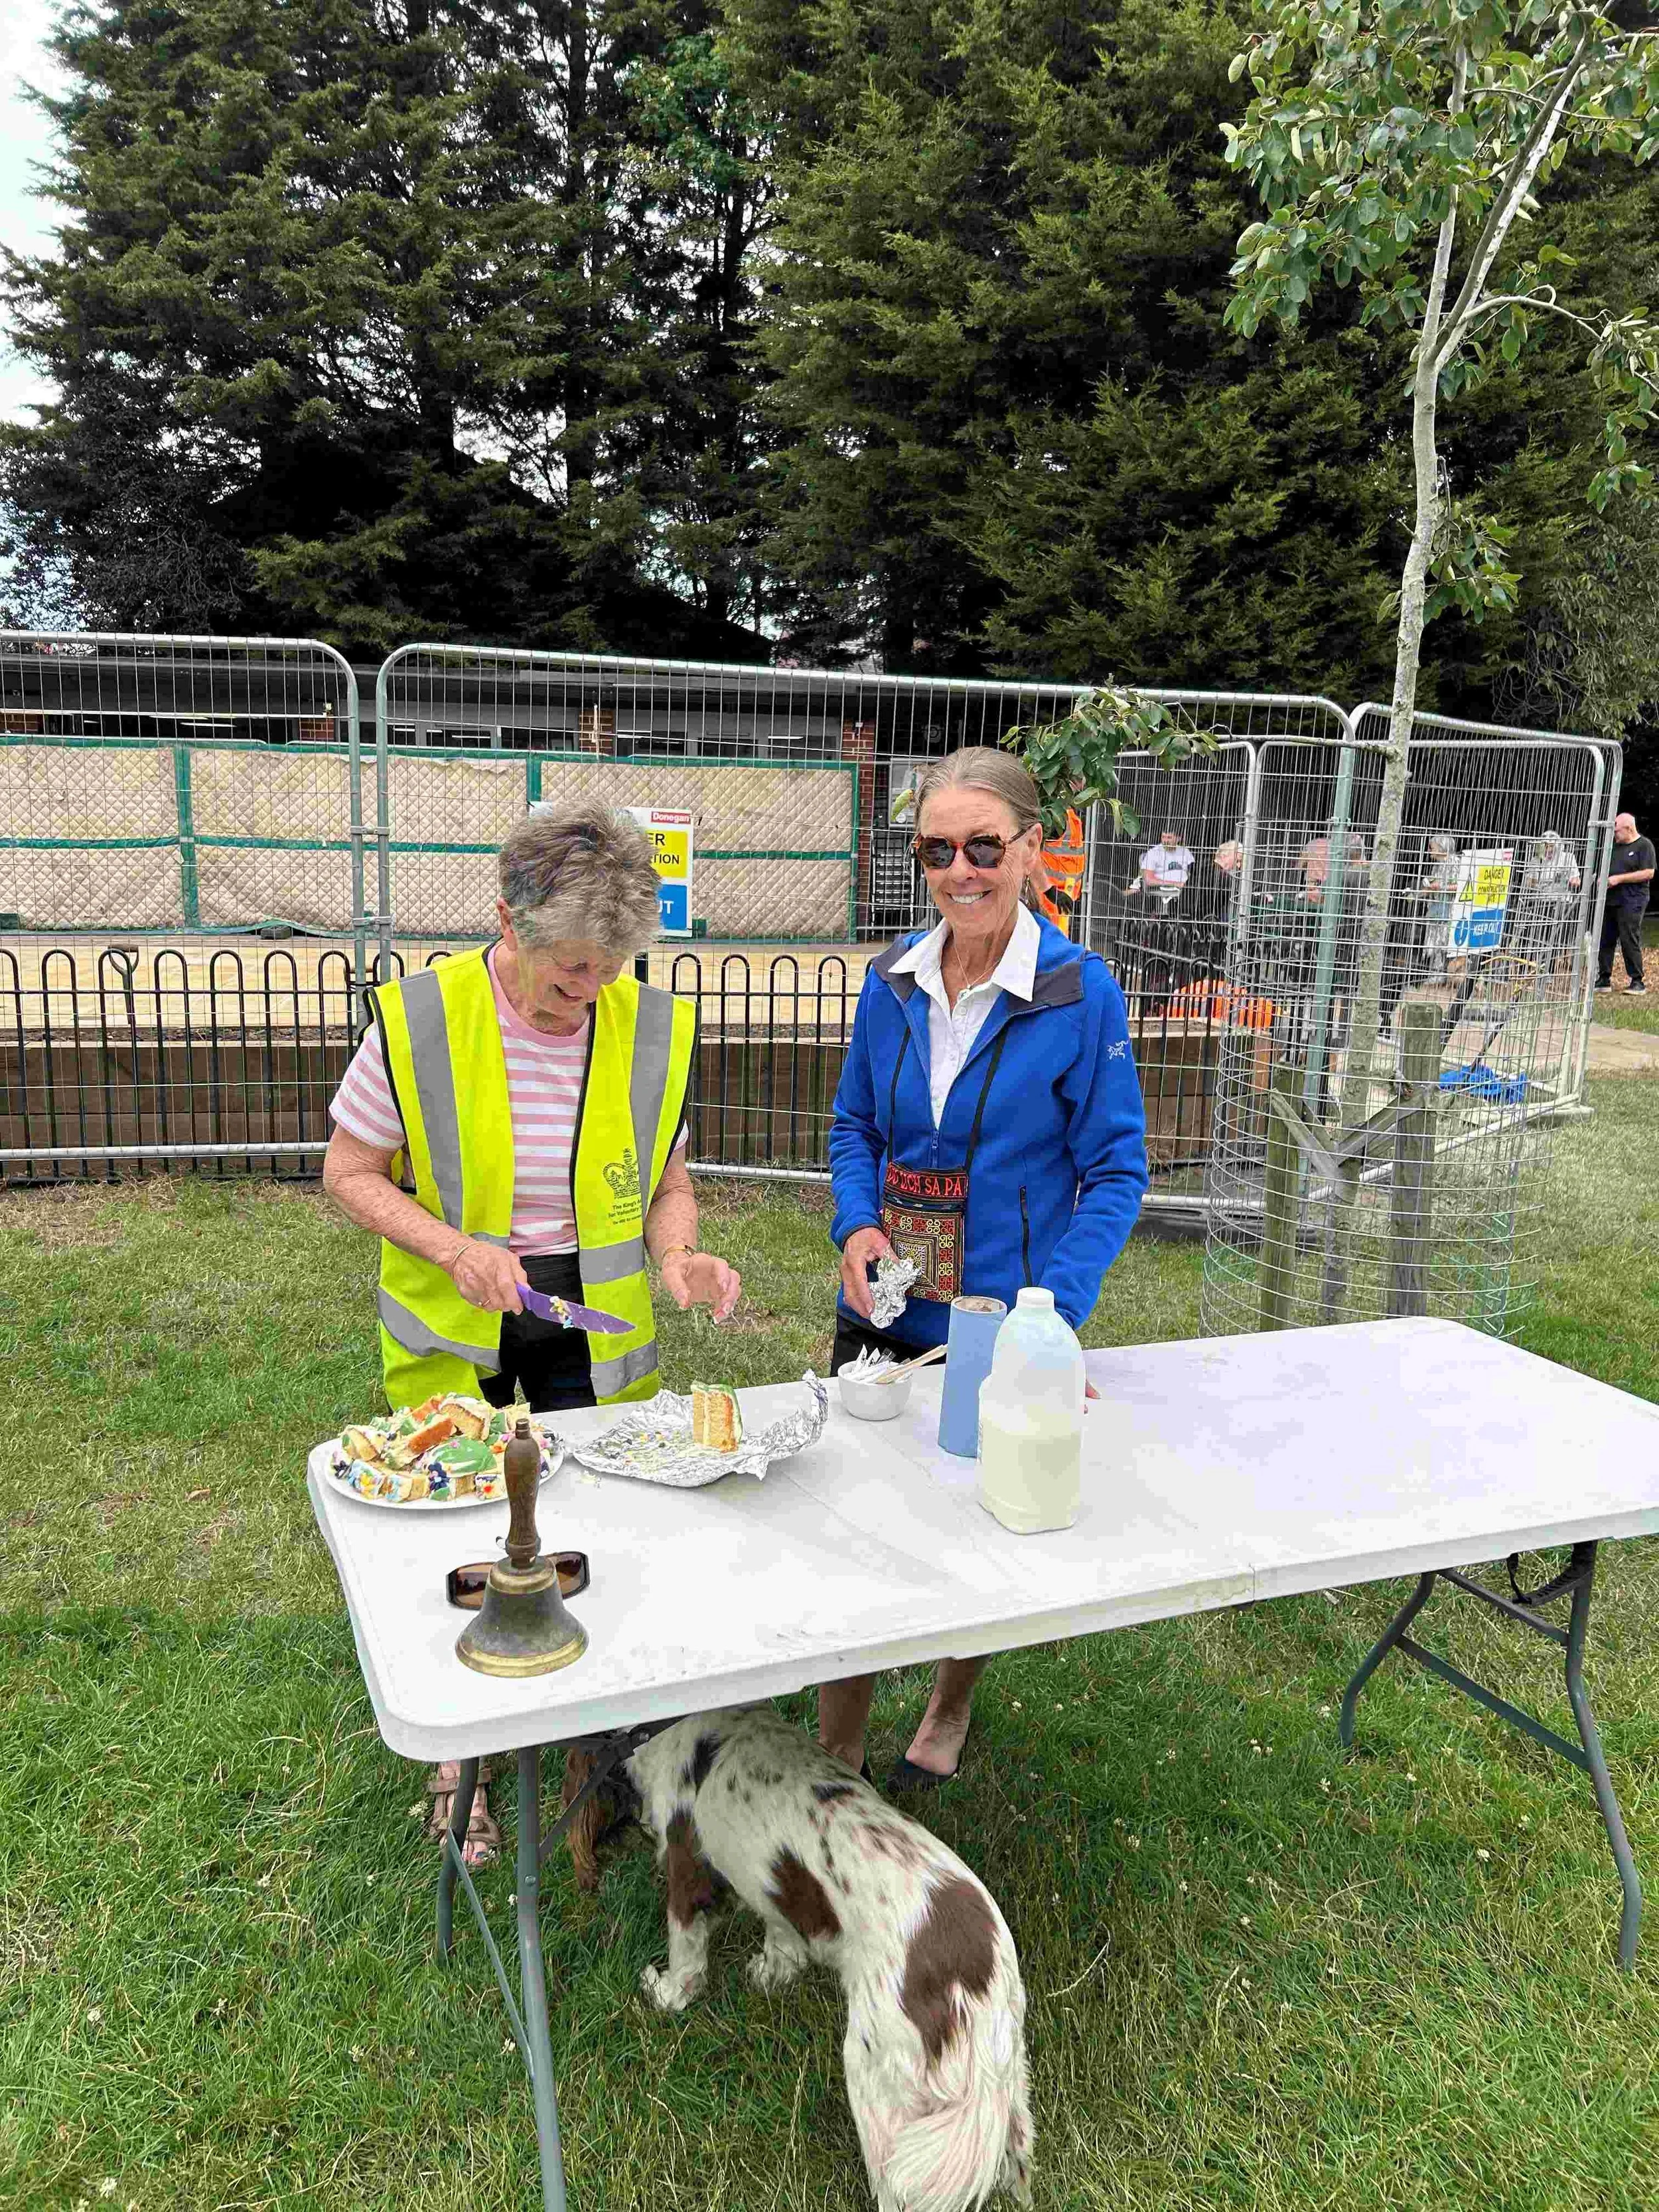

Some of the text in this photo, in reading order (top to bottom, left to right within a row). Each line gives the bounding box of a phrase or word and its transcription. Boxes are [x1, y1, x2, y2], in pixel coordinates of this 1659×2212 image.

[652, 812, 689, 823] Donegan
[1484, 869, 1504, 880] DANGER
[925, 1176, 940, 1195] SA
[944, 1176, 963, 1196] PA
